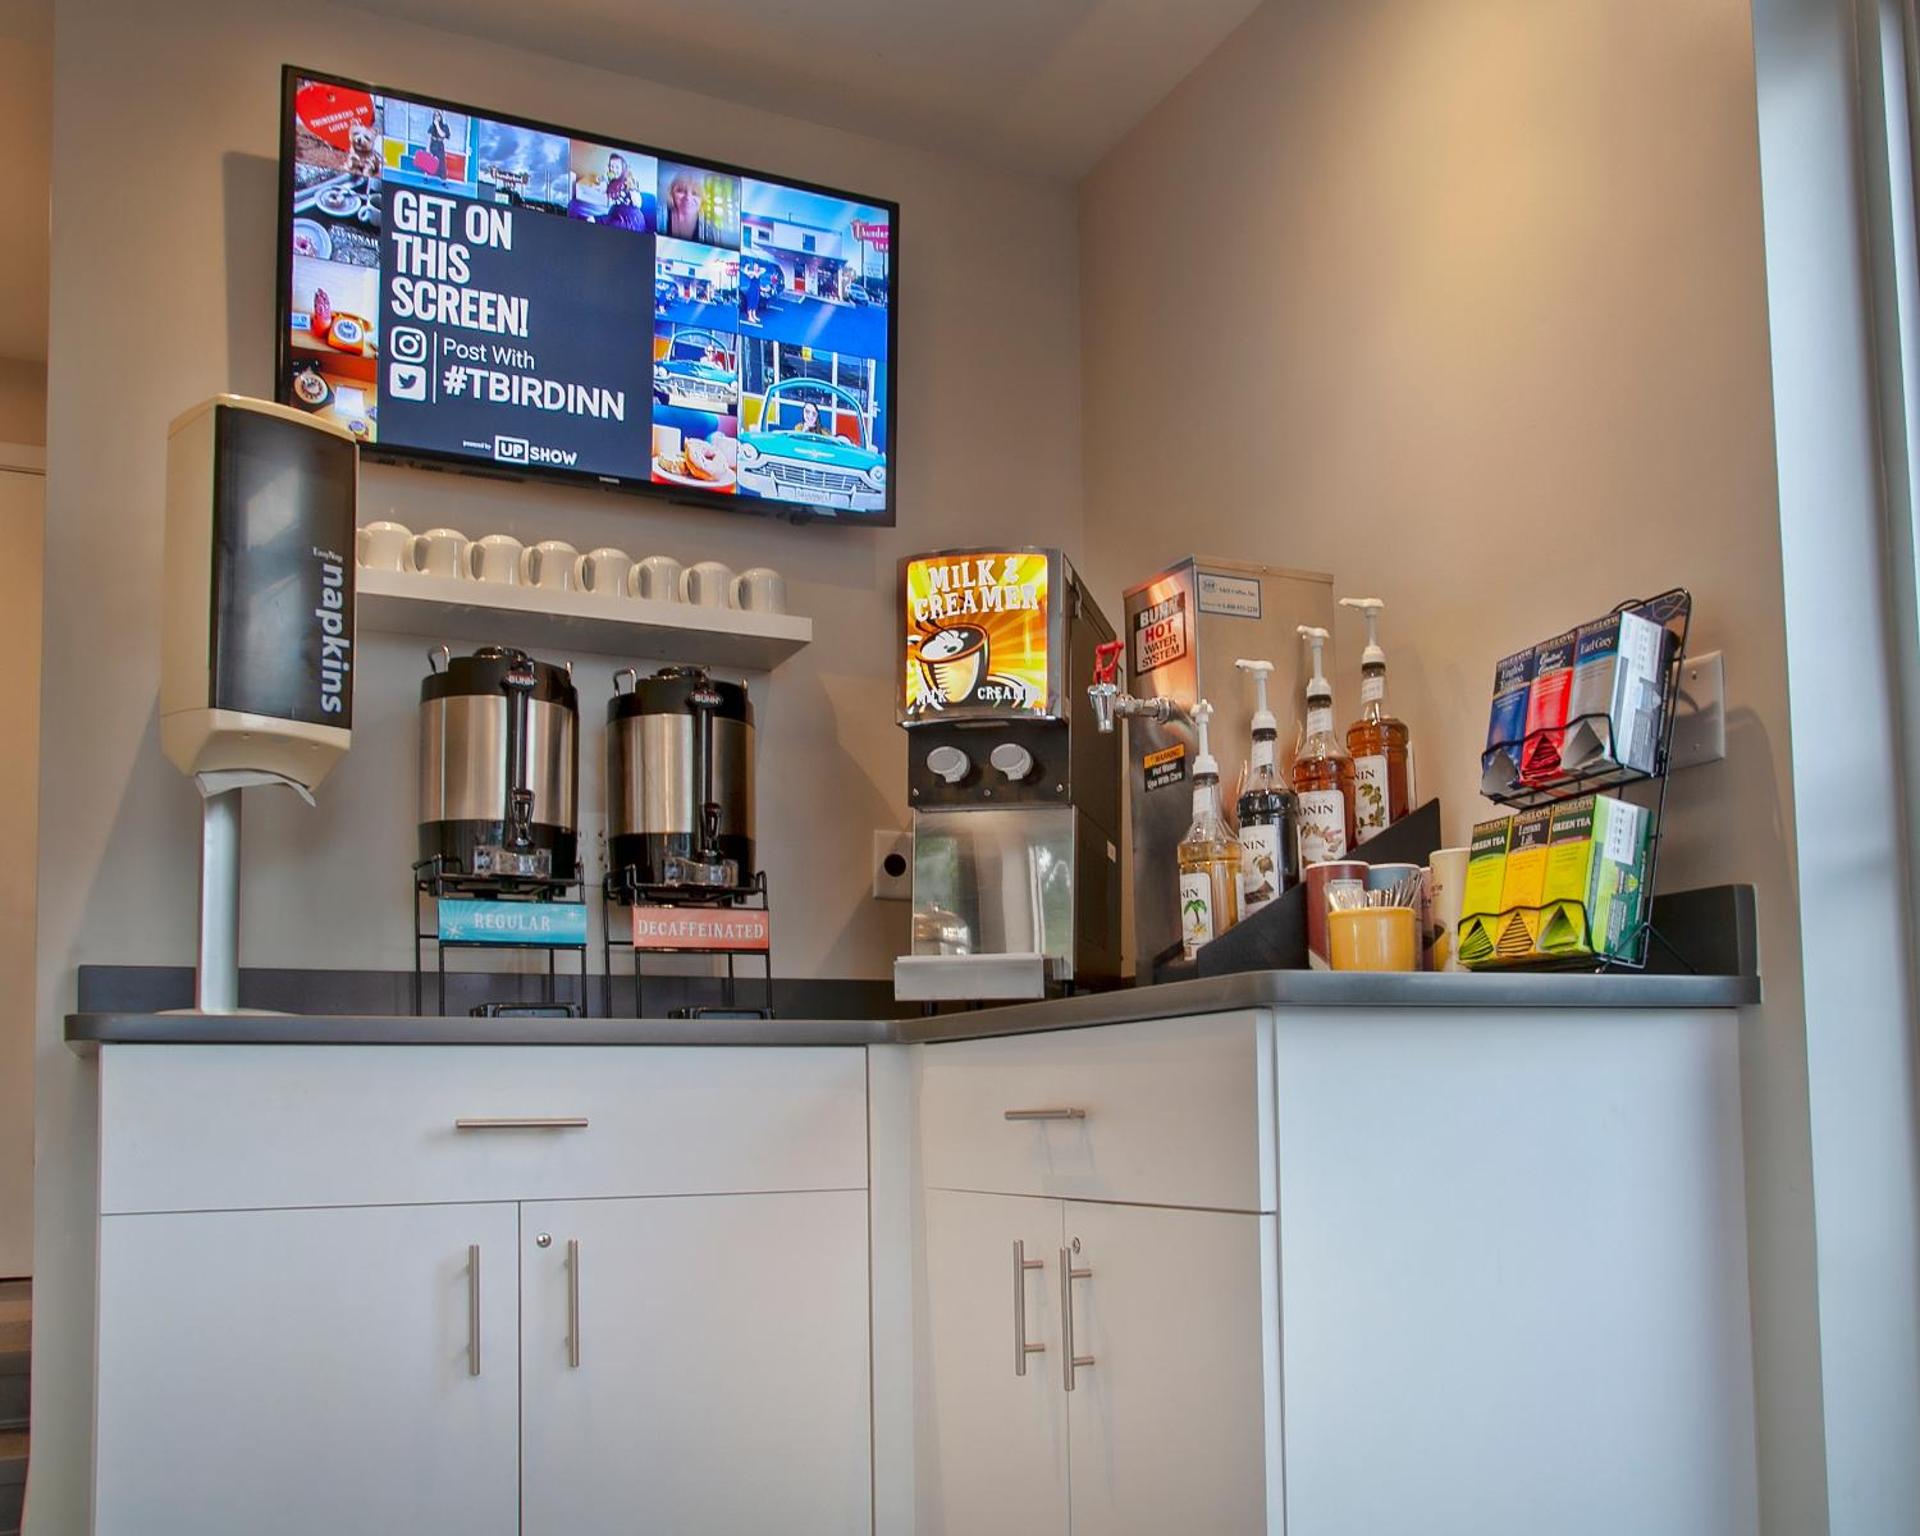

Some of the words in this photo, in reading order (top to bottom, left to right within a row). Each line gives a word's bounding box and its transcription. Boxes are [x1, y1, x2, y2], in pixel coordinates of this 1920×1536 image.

[393, 190, 457, 238] GET
[465, 204, 512, 250] ON
[391, 232, 470, 284] THIS
[391, 276, 529, 338] SCREEN!
[443, 337, 487, 362] Post
[492, 345, 536, 370] With
[443, 364, 625, 421] #TBIRDINN
[928, 559, 998, 593] MILK
[1003, 557, 1020, 583] &
[914, 584, 1040, 622] CREAMER
[315, 563, 350, 713] napkins
[1144, 634, 1177, 655] WATER
[1145, 619, 1174, 642] HOT
[1142, 644, 1180, 668] SYSTEM
[1553, 819, 1575, 832] GREEN
[1576, 817, 1591, 829] TEA
[1472, 838, 1492, 851] GREEN
[1492, 836, 1506, 847] TEA
[474, 912, 551, 932] REGULAR
[638, 919, 765, 939] DECAFFEINATED
